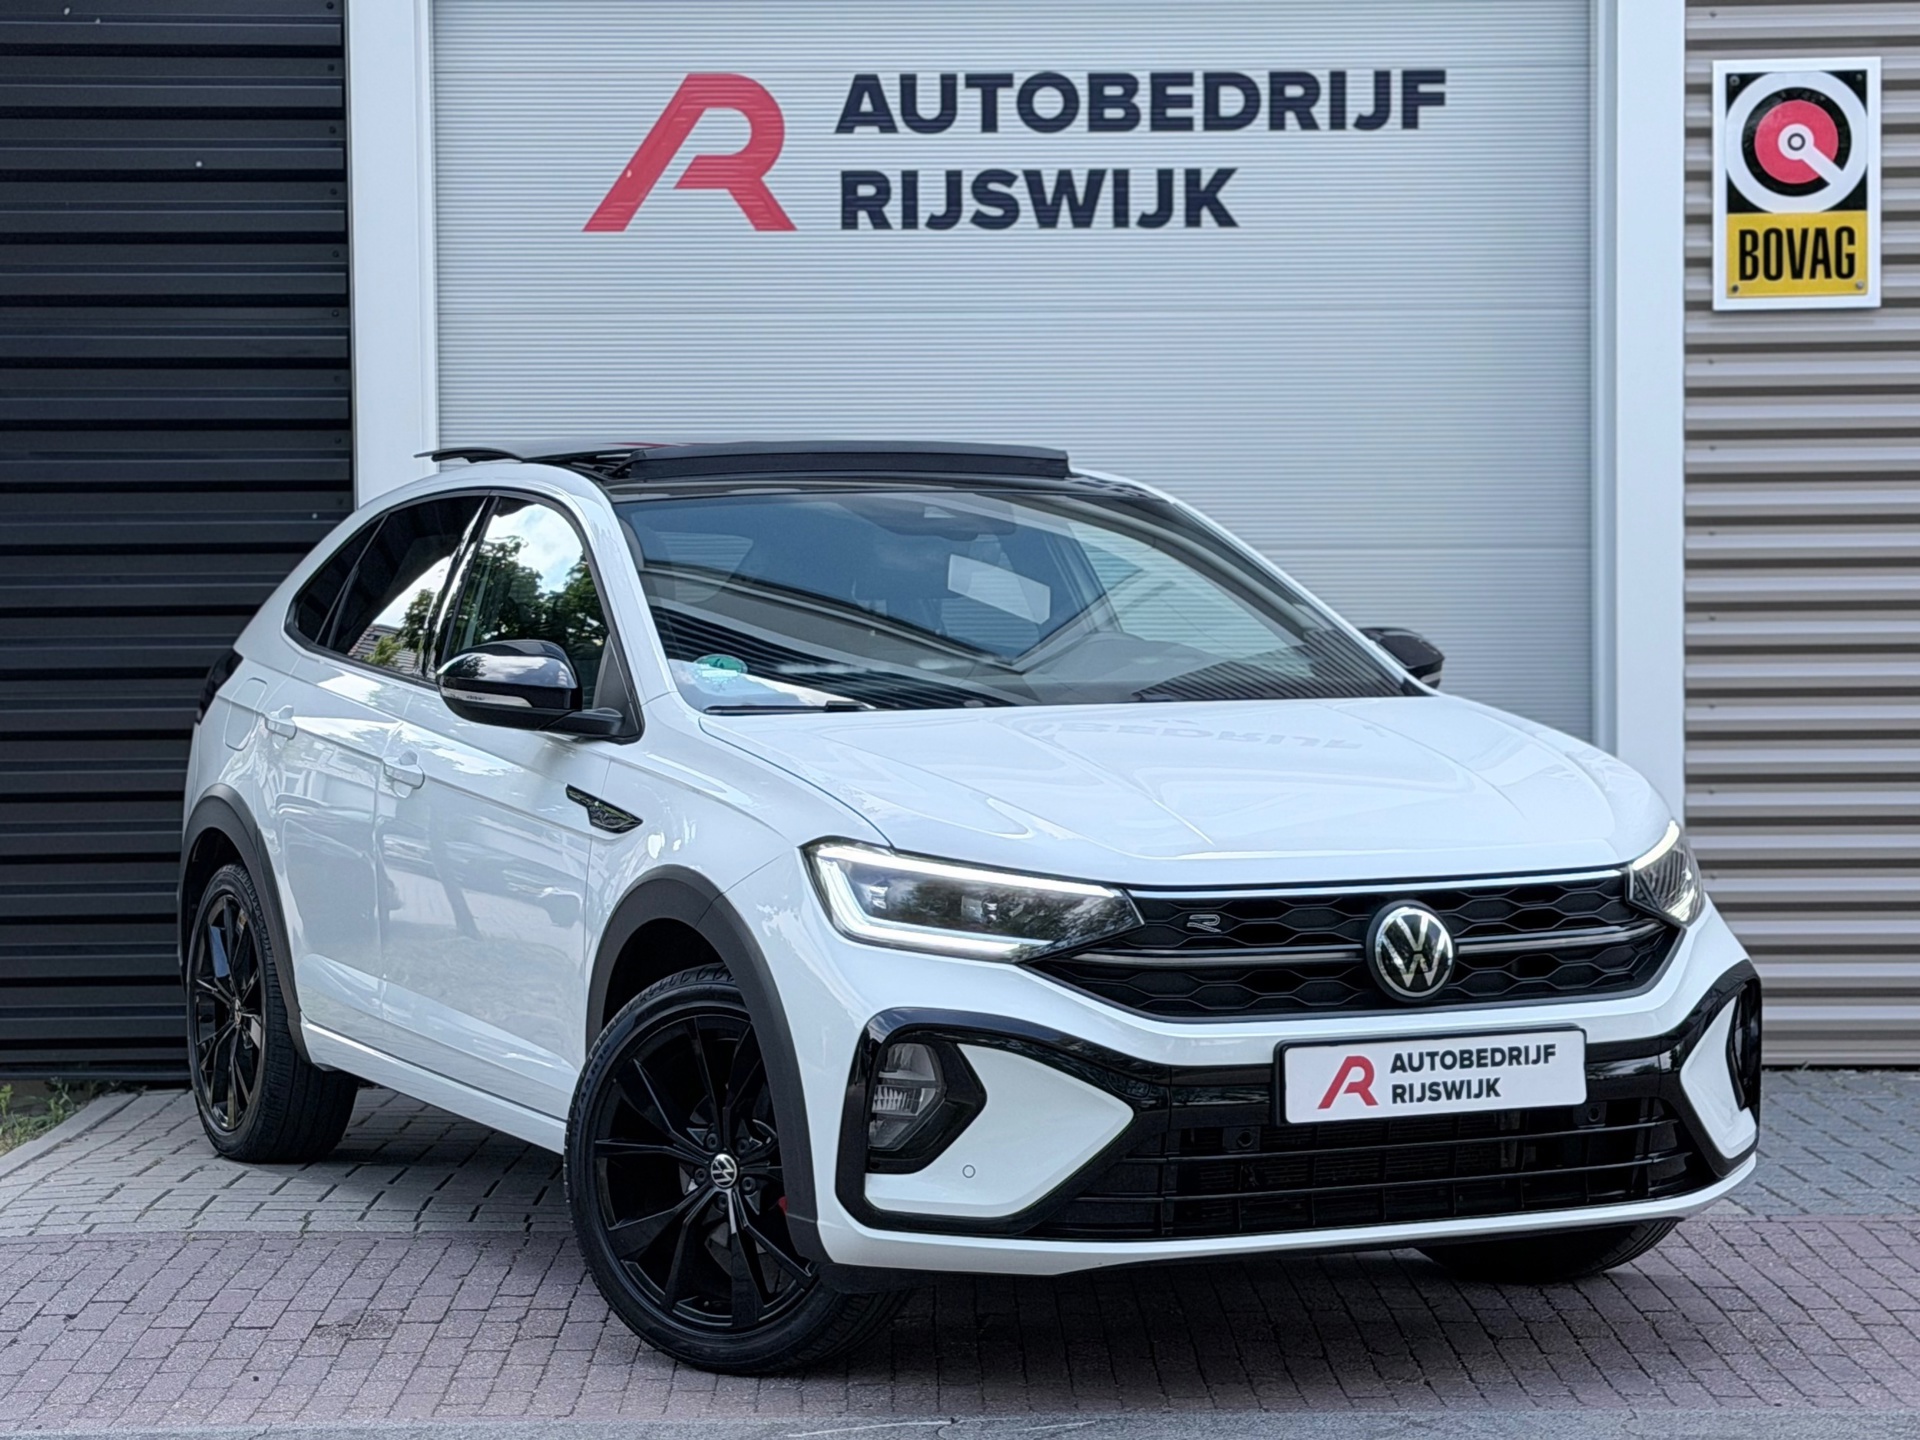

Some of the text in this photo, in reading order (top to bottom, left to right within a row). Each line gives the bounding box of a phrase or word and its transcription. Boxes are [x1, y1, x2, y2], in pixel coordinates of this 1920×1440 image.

[835, 69, 1447, 135] AUTOBEDRIJF
[840, 168, 1239, 230] RIJSWIJK
[1738, 225, 1856, 281] BOVAG
[1390, 1044, 1556, 1074] AUTOBEDRIJF
[1391, 1077, 1502, 1104] RIJSWIJK
